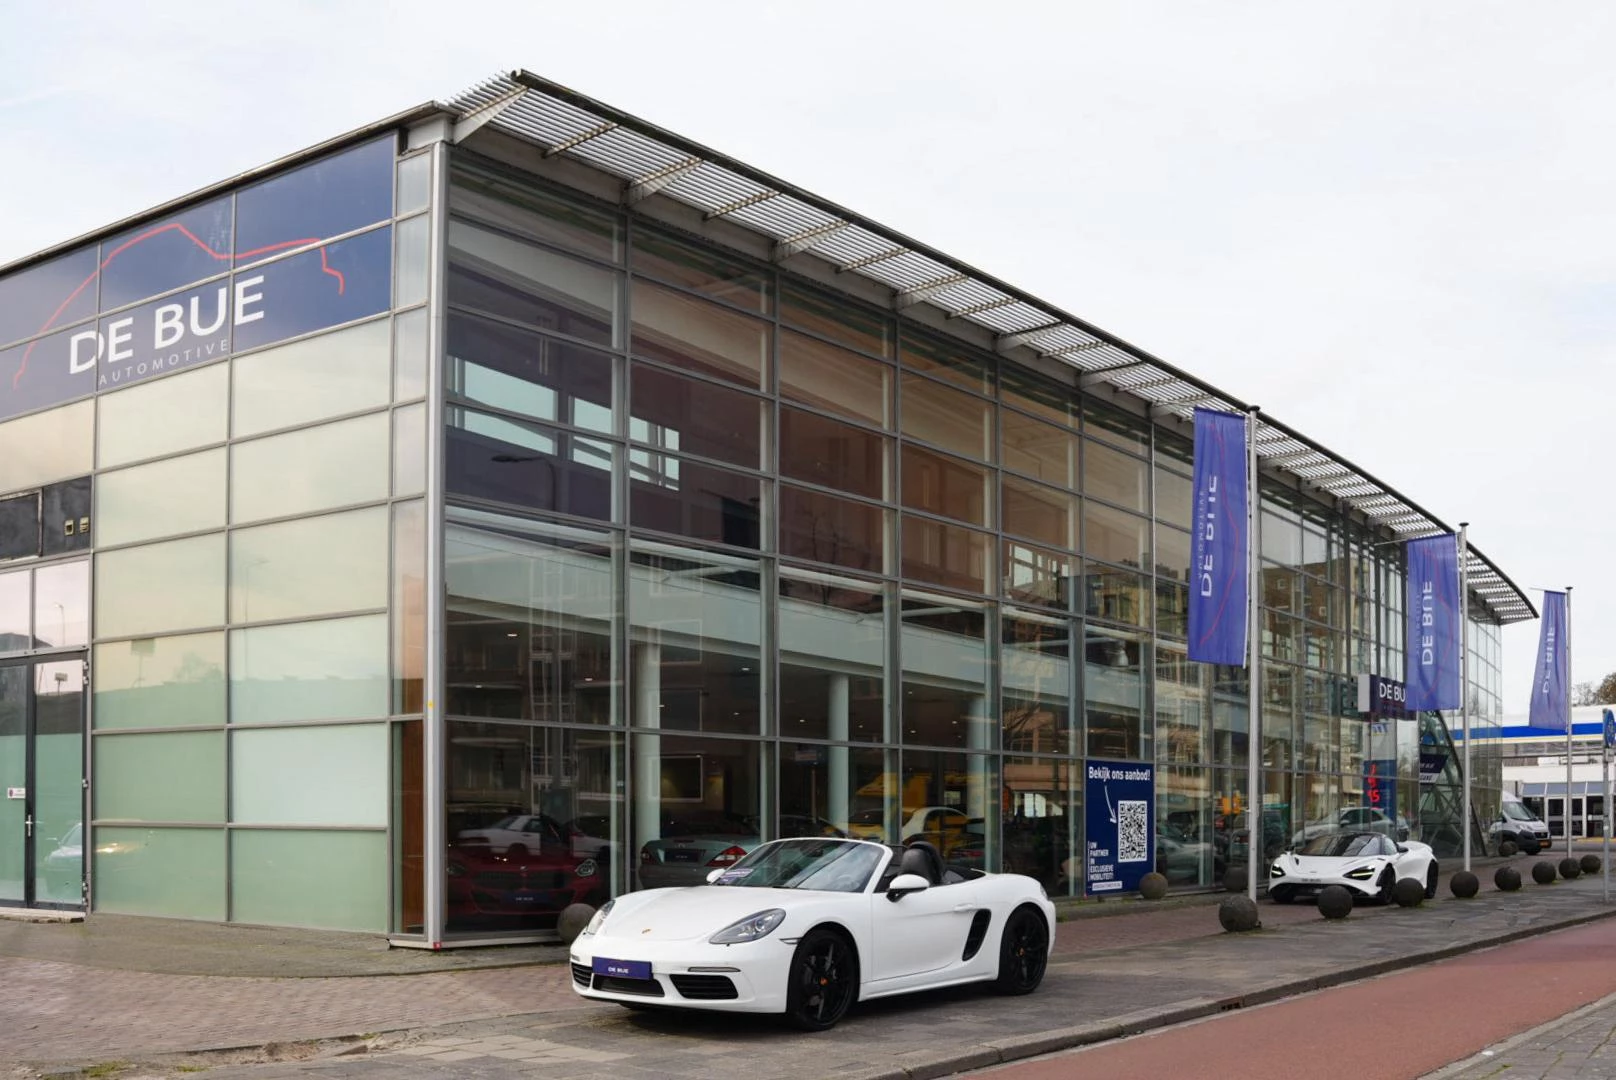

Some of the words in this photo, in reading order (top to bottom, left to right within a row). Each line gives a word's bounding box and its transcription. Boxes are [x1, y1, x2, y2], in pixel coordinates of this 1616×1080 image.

[69, 317, 134, 375] DE
[154, 275, 265, 350] BUE
[98, 338, 229, 386] AUTOMOTIVE
[1379, 682, 1393, 700] DE
[1394, 686, 1406, 703] BU
[1088, 766, 1111, 782] Bekijk
[1111, 770, 1124, 780] ons
[1125, 768, 1151, 781] aanbod!
